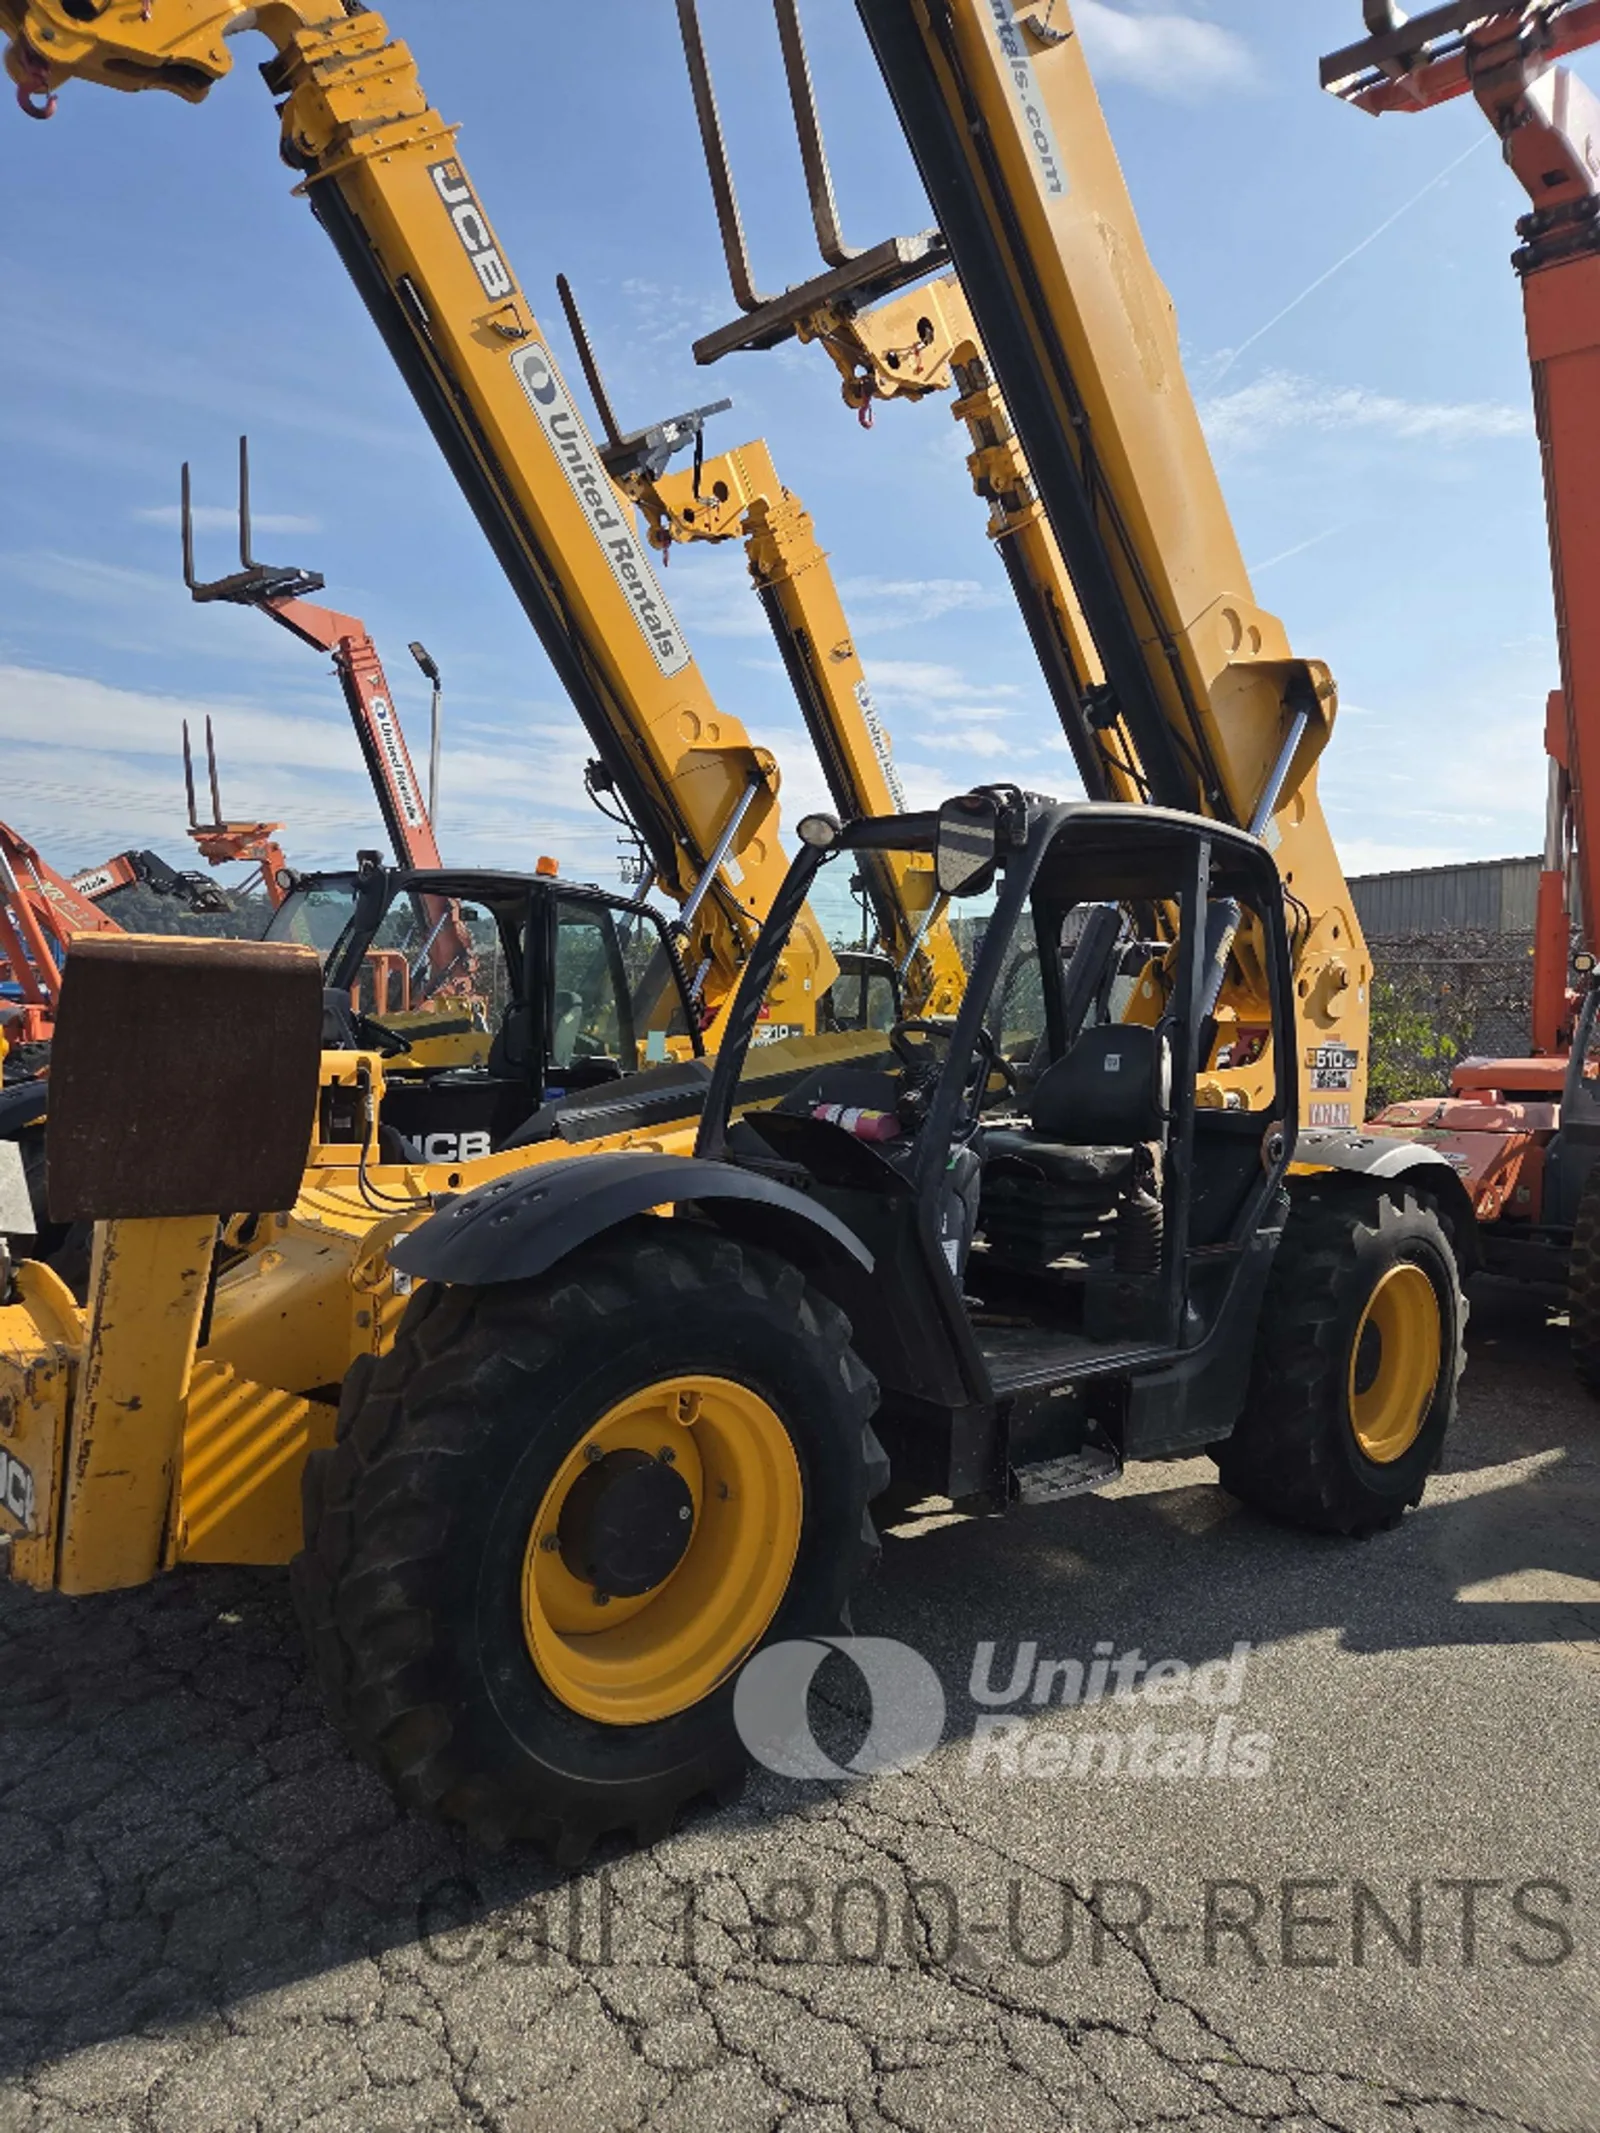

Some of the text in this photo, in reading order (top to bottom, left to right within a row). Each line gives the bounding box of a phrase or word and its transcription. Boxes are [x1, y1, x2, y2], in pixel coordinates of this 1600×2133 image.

[432, 165, 512, 298] JCB
[549, 412, 675, 659] United Rentals
